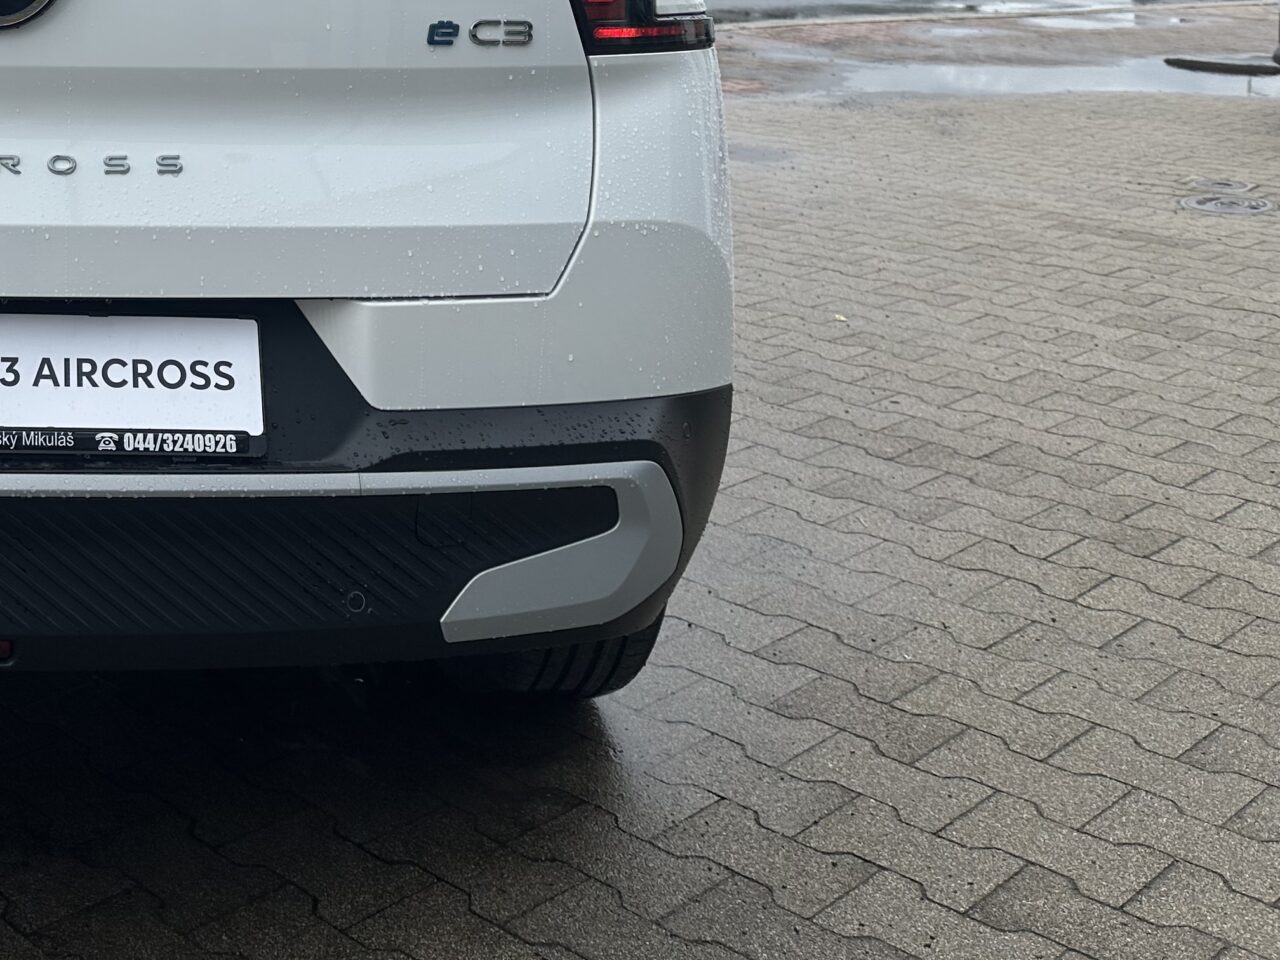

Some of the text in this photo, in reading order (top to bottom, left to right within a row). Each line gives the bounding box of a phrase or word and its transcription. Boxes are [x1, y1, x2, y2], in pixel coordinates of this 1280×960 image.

[32, 356, 236, 391] AIRCROSS
[22, 431, 75, 447] Mikuláš
[123, 433, 237, 453] 044/3240926
